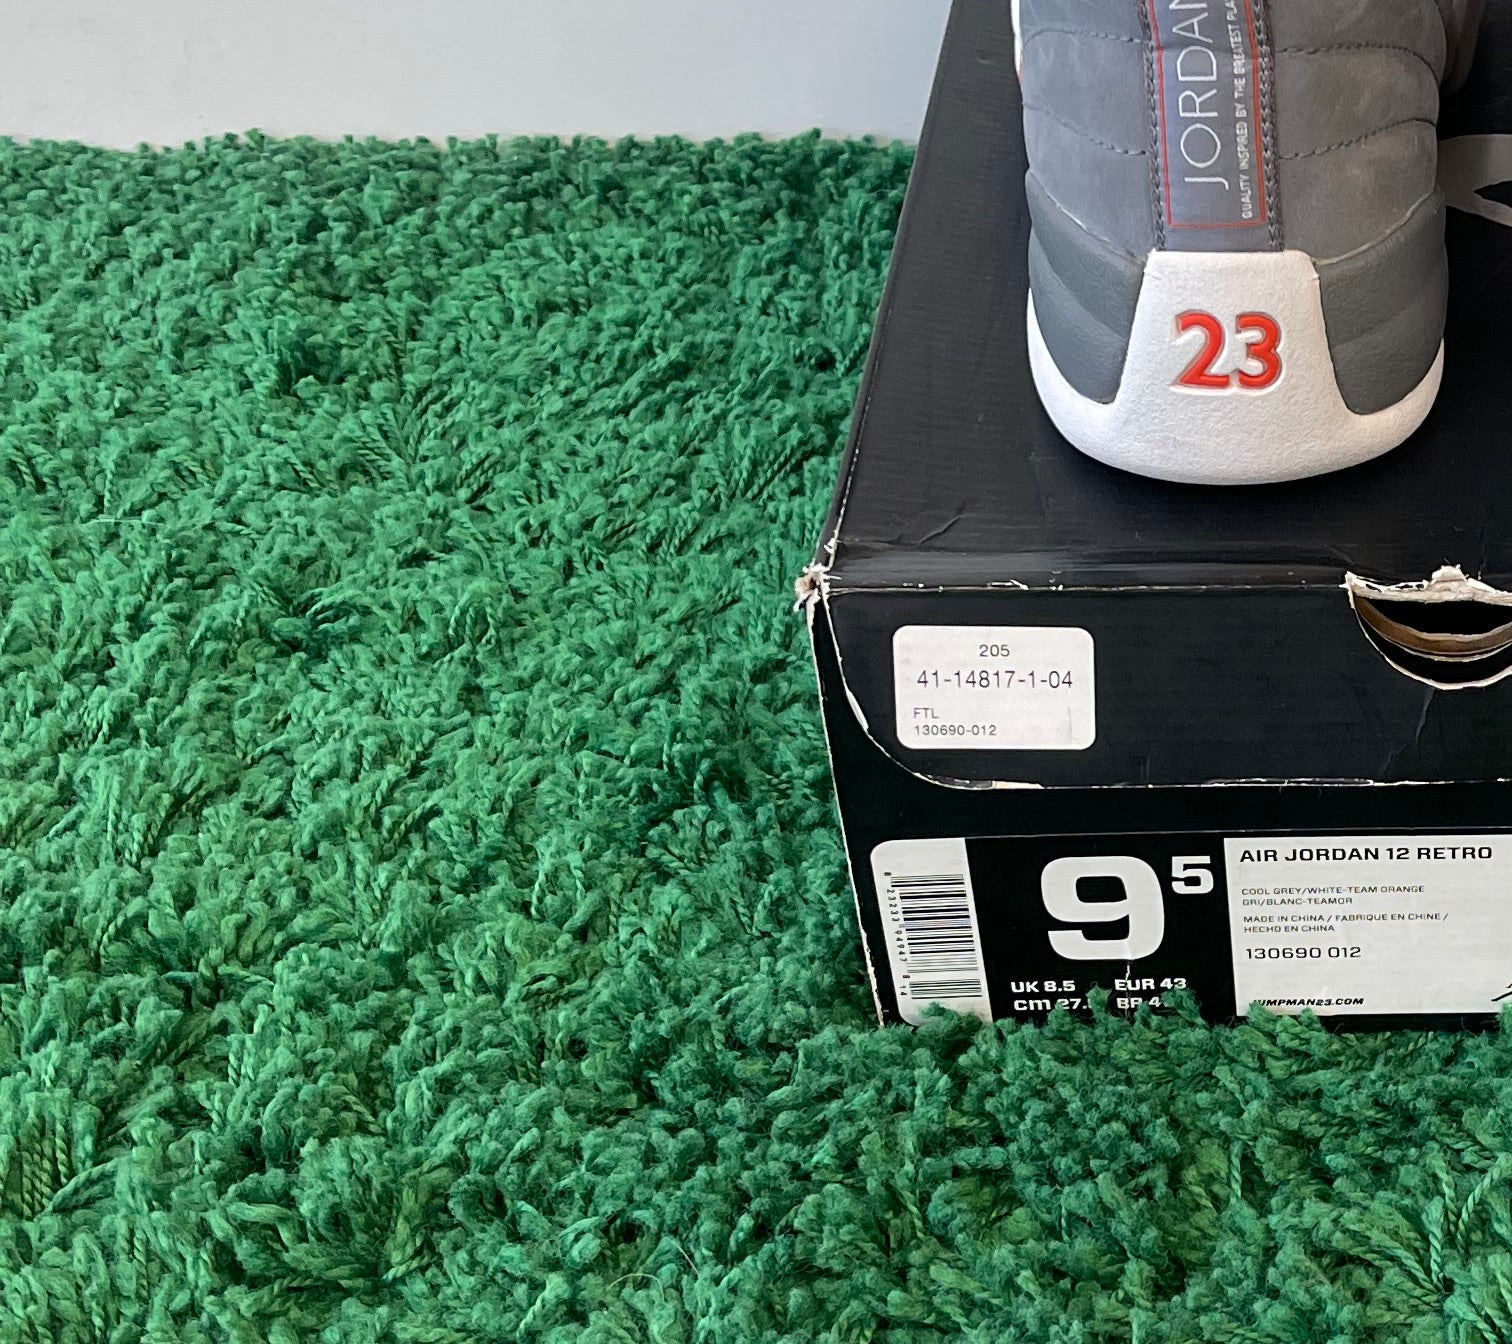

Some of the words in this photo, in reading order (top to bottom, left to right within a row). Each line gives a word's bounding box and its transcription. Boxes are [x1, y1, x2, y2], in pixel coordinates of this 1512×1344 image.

[1234, 77, 1246, 99] THE
[1235, 102, 1247, 118] BY
[1235, 121, 1250, 170] INSPIRED
[1239, 173, 1253, 219] QUALITY
[1173, 310, 1282, 389] 23
[978, 644, 1010, 657] 205
[917, 670, 1073, 689] 41-14817-1-04
[913, 707, 939, 719] FTL
[914, 724, 997, 736] 130690-012
[1239, 849, 1278, 863] AIR
[1284, 847, 1380, 862] JORDAN
[1386, 847, 1410, 860] 12
[1417, 846, 1493, 860] RETRO
[1273, 886, 1377, 895] GREY/WHITE-TEAM
[1380, 885, 1425, 893] ORANGE
[1242, 897, 1353, 906] GRI/BLANC-TEAMOR
[1243, 915, 1274, 923] MADE
[1291, 914, 1324, 922] CHINA
[1335, 913, 1388, 922] FABRIQUE
[1391, 913, 1405, 921] EN
[1407, 912, 1440, 921] CHINE
[1284, 925, 1298, 933] EN
[1301, 924, 1335, 932] CHINA
[1246, 947, 1321, 959] 130690
[1328, 946, 1361, 958] 012
[1010, 981, 1040, 993] UK
[1043, 979, 1076, 992] 8.5
[1114, 978, 1155, 991] EUR
[1159, 977, 1187, 990] 43
[1056, 998, 1092, 1010] 27.
[1253, 997, 1364, 1007] UMPMAN23.COM
